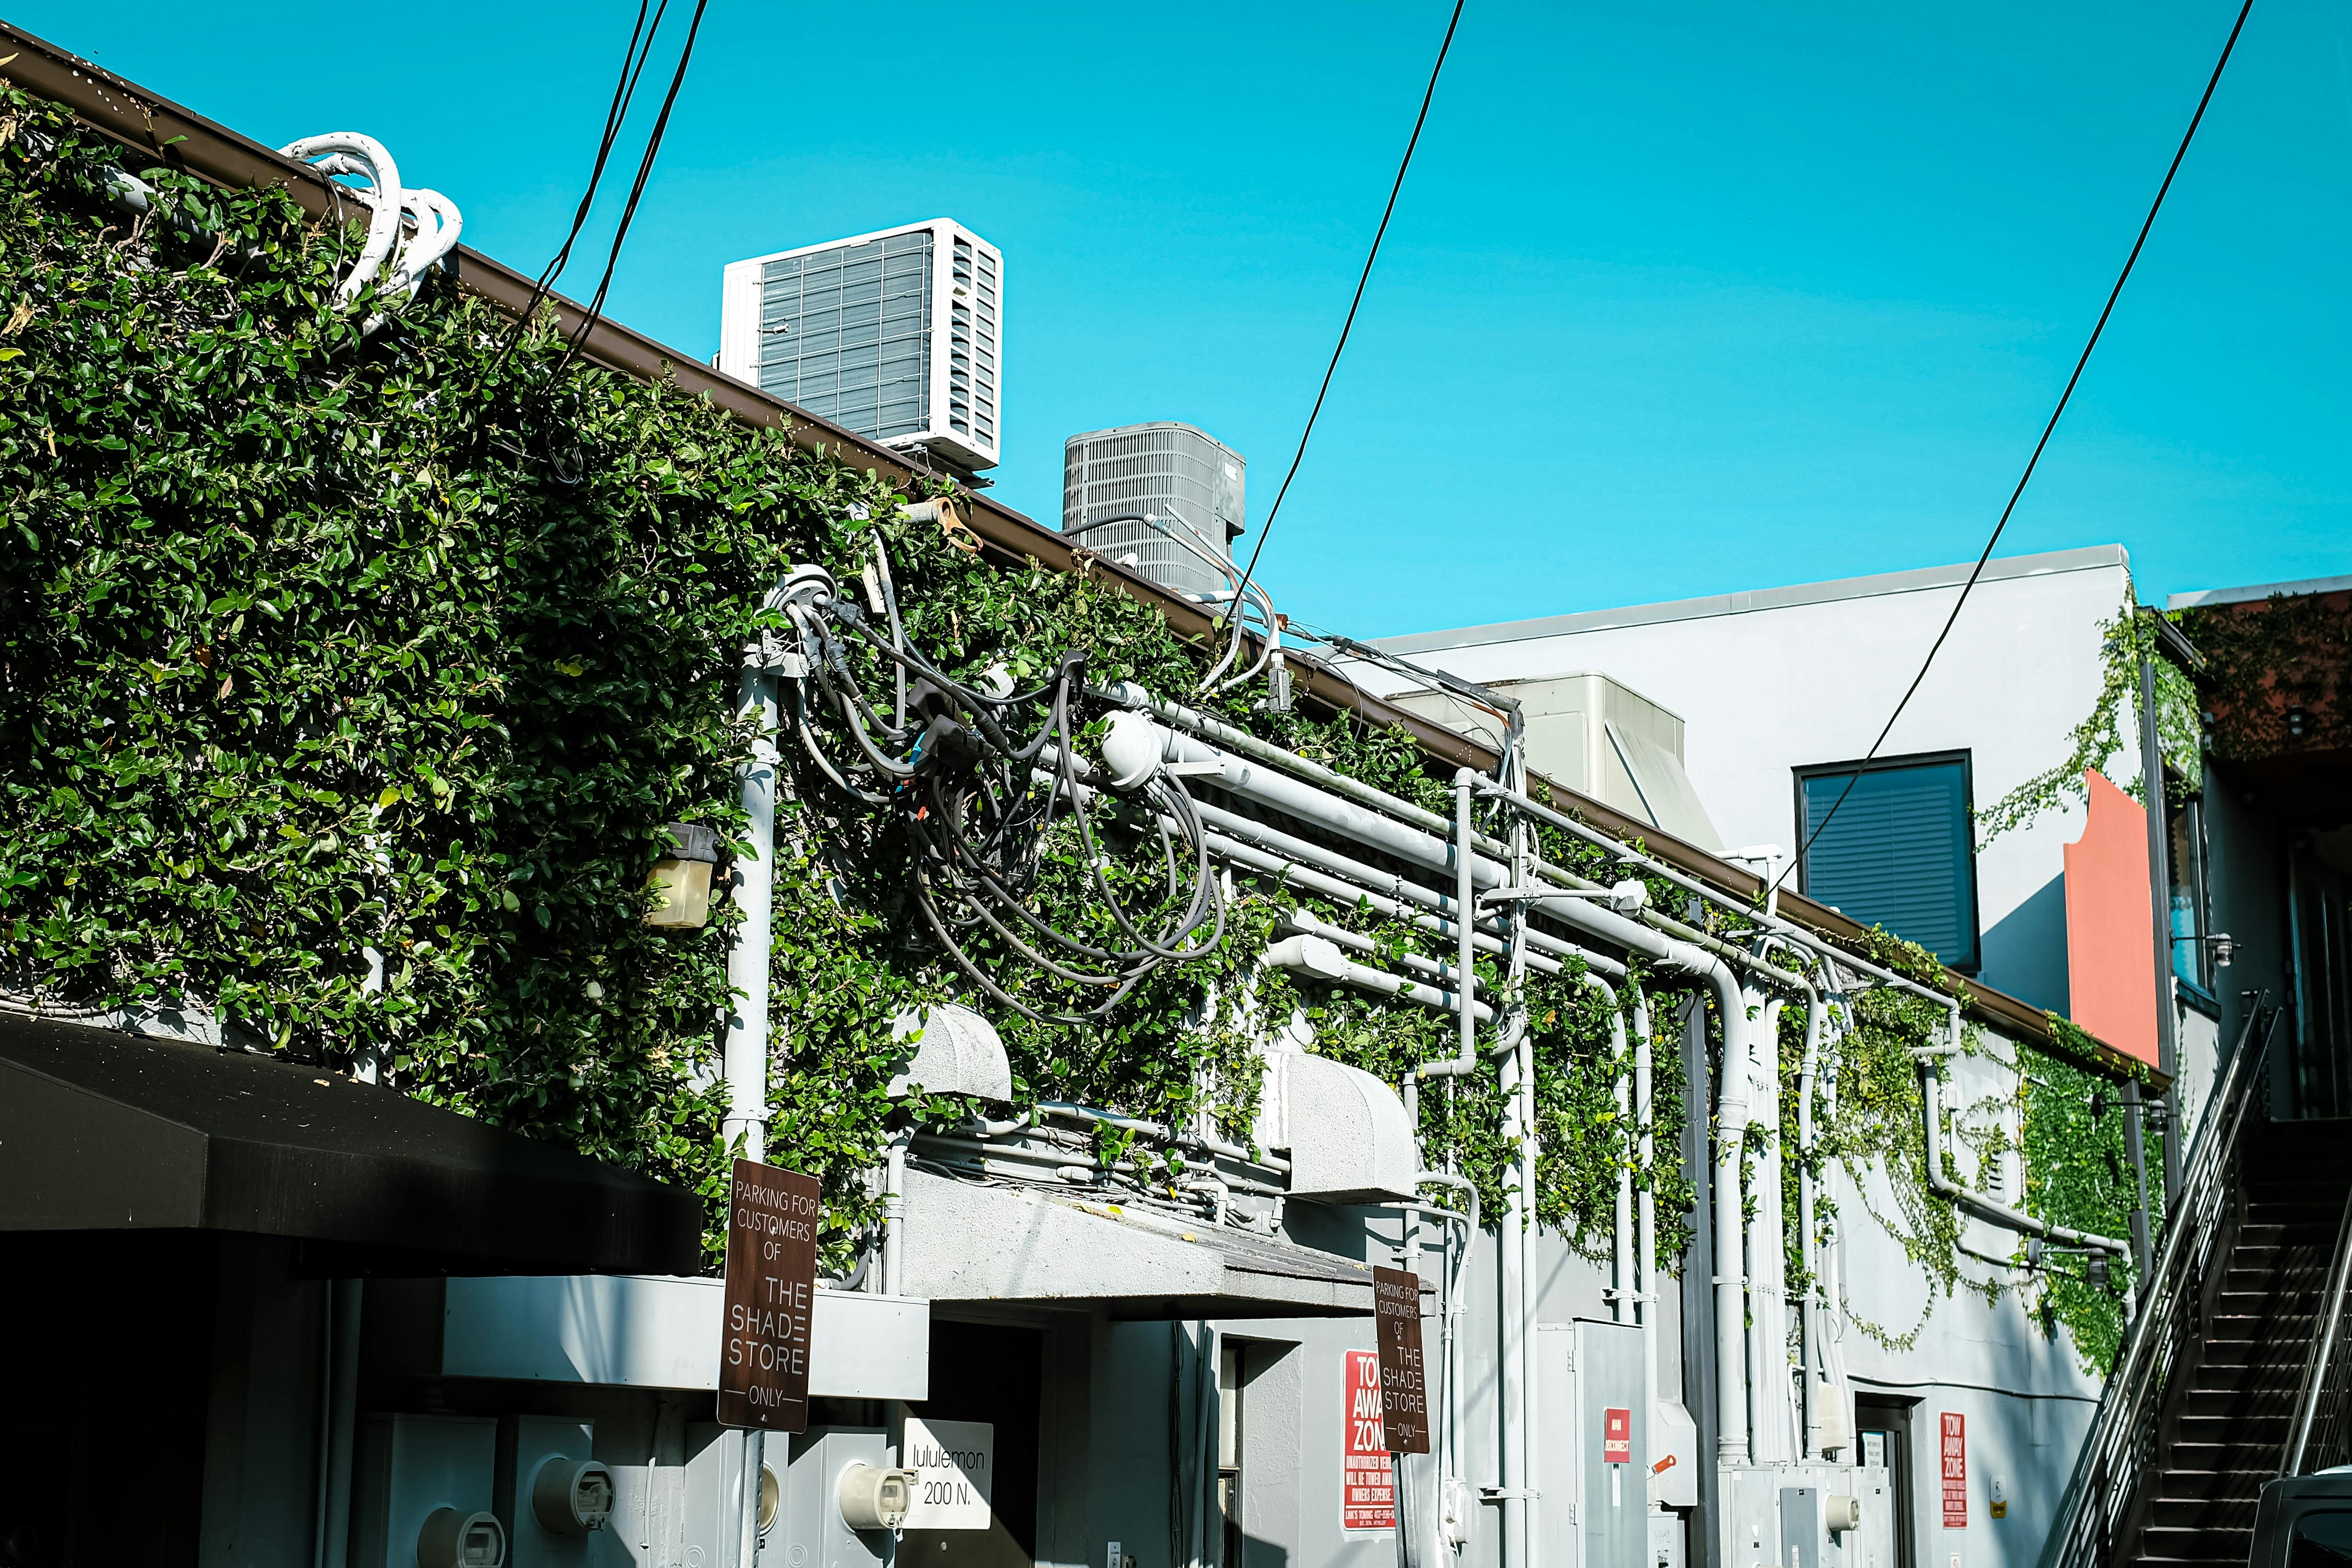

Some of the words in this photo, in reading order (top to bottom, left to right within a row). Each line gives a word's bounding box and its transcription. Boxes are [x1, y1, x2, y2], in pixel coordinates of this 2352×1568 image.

[736, 1181, 788, 1211] PARKING
[792, 1195, 816, 1217] FOR
[737, 1209, 810, 1242] CUSTOMERS
[764, 1241, 781, 1261] OF
[766, 1276, 807, 1309] THE
[1376, 1280, 1404, 1299] PARKING
[1405, 1287, 1418, 1302] FOR
[1379, 1300, 1417, 1320] CUSTOMERS
[731, 1304, 805, 1342] SHADE
[1394, 1321, 1403, 1335] OF
[729, 1338, 804, 1375] STORE
[1397, 1346, 1420, 1367] THE
[1357, 1356, 1381, 1388] TO
[1383, 1367, 1422, 1390] SHADE
[749, 1385, 783, 1408] ONLY
[1352, 1388, 1383, 1419] AWA
[1385, 1391, 1424, 1414] STORE
[1353, 1420, 1385, 1452] ZON
[1398, 1422, 1415, 1437] ONLY
[1944, 1415, 1961, 1436] TOW
[913, 1444, 984, 1470] lululemon
[1943, 1436, 1963, 1457] AWAY
[1346, 1472, 1357, 1485] WILL
[1358, 1472, 1364, 1485] BE
[1365, 1472, 1381, 1485] TOWED
[1944, 1457, 1963, 1478] ZONE
[924, 1481, 952, 1505] 200
[957, 1482, 970, 1505] N.
